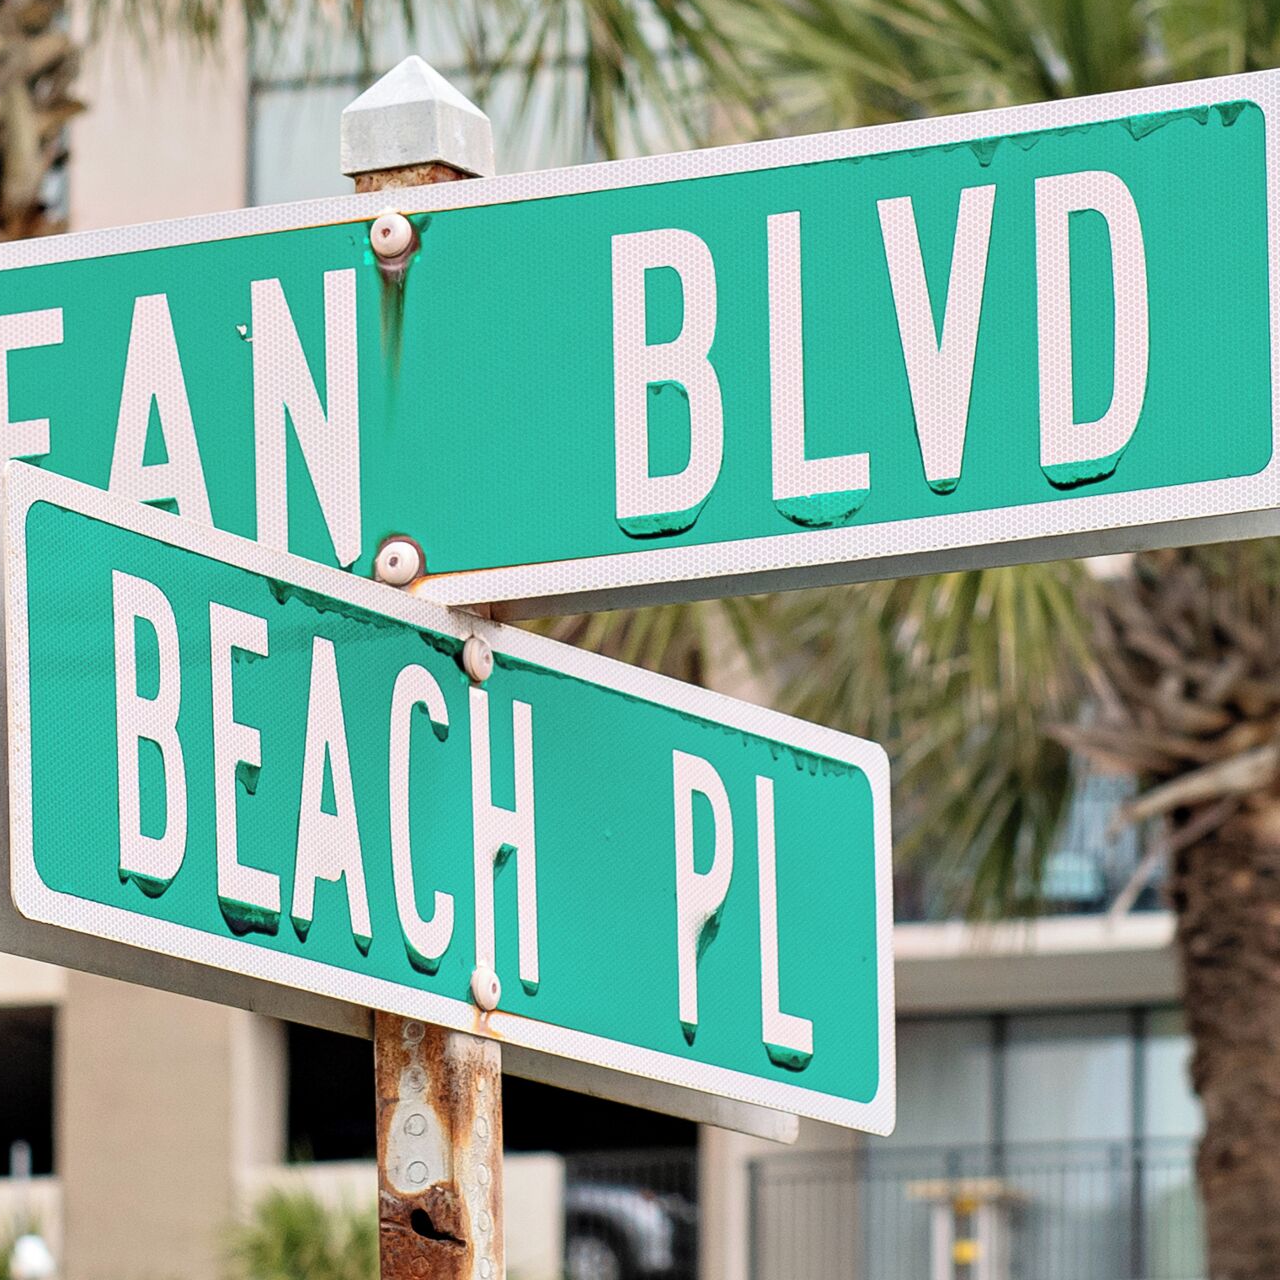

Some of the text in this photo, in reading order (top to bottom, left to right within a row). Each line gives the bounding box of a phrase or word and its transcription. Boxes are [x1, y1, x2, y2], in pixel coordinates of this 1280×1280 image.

[611, 170, 1150, 520] BLVD
[111, 569, 814, 1056] BEACH PL
